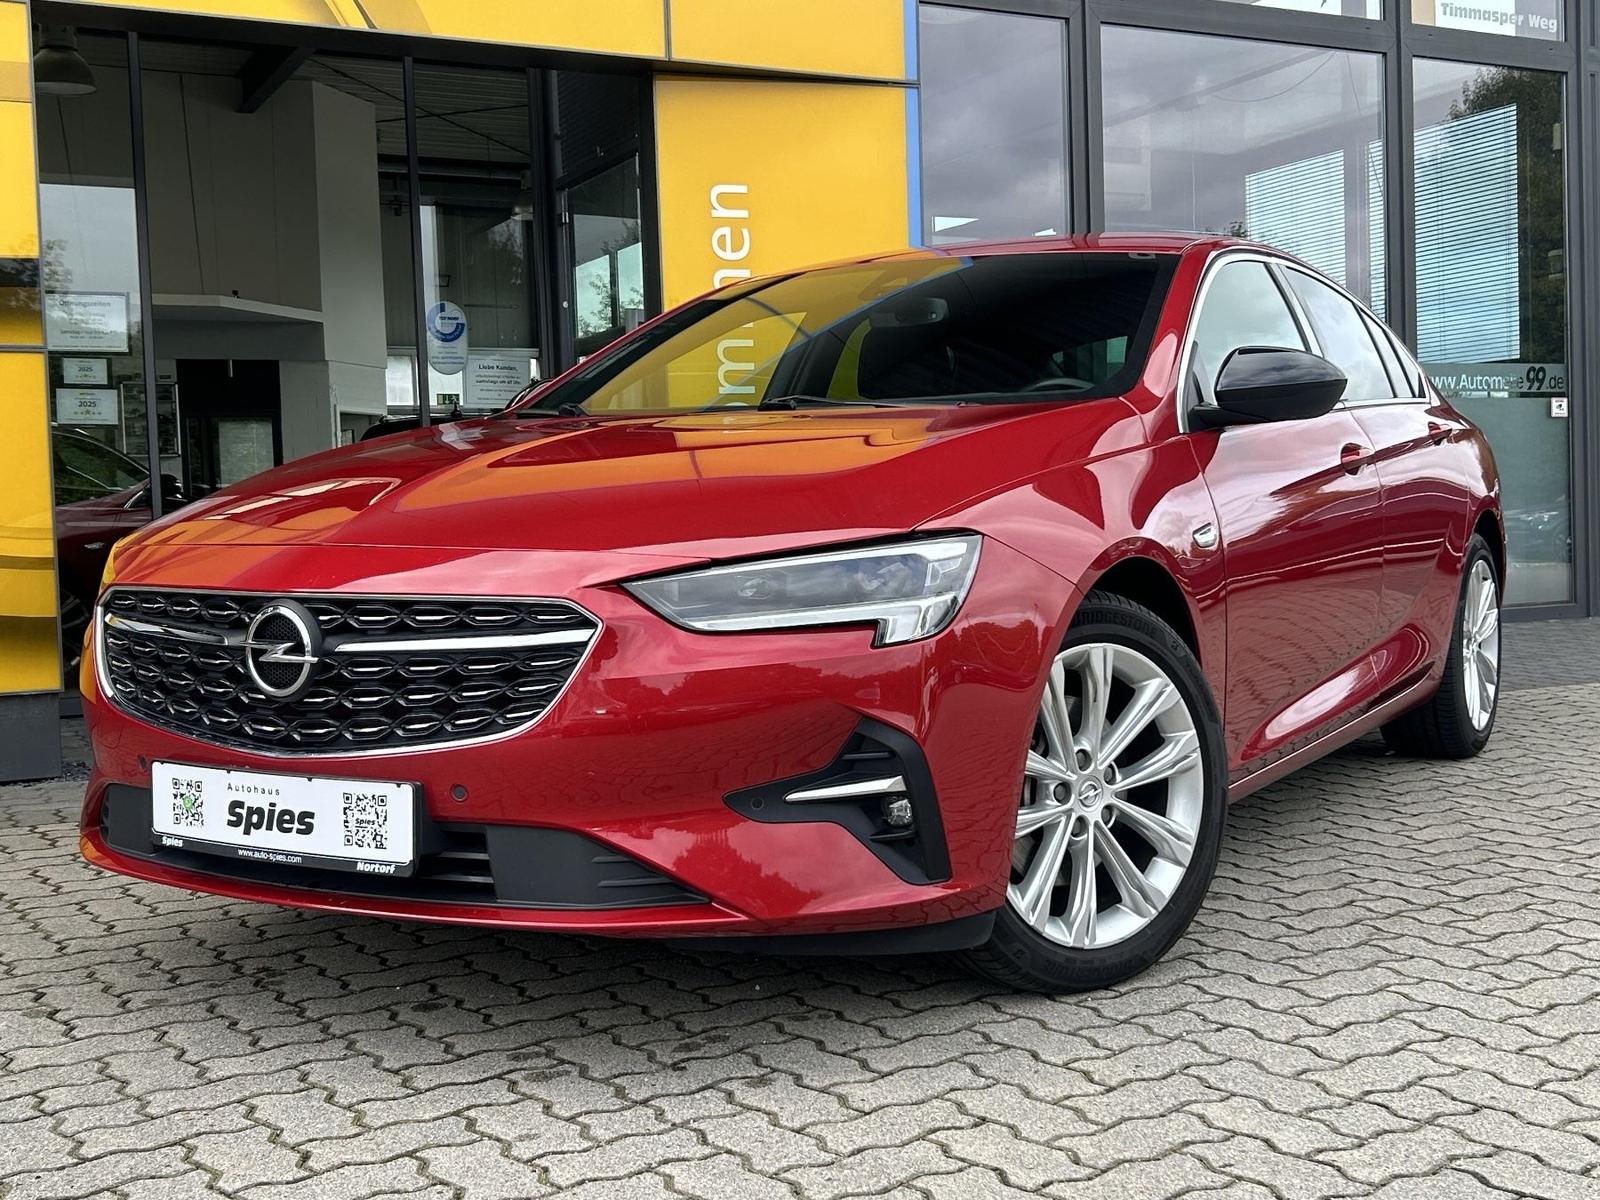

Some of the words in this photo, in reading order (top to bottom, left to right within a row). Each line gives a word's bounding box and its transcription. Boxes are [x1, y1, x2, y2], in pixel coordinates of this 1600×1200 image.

[1440, 2, 1524, 26] Timmasper
[1528, 14, 1558, 33] Weg
[78, 400, 97, 408] 2025
[226, 781, 281, 797] Autohaus
[226, 799, 316, 837] Spies
[355, 817, 376, 827] Spies
[161, 835, 184, 848] Spies
[237, 848, 303, 865] www.auto-spies.com
[356, 861, 397, 875] Nortorf
